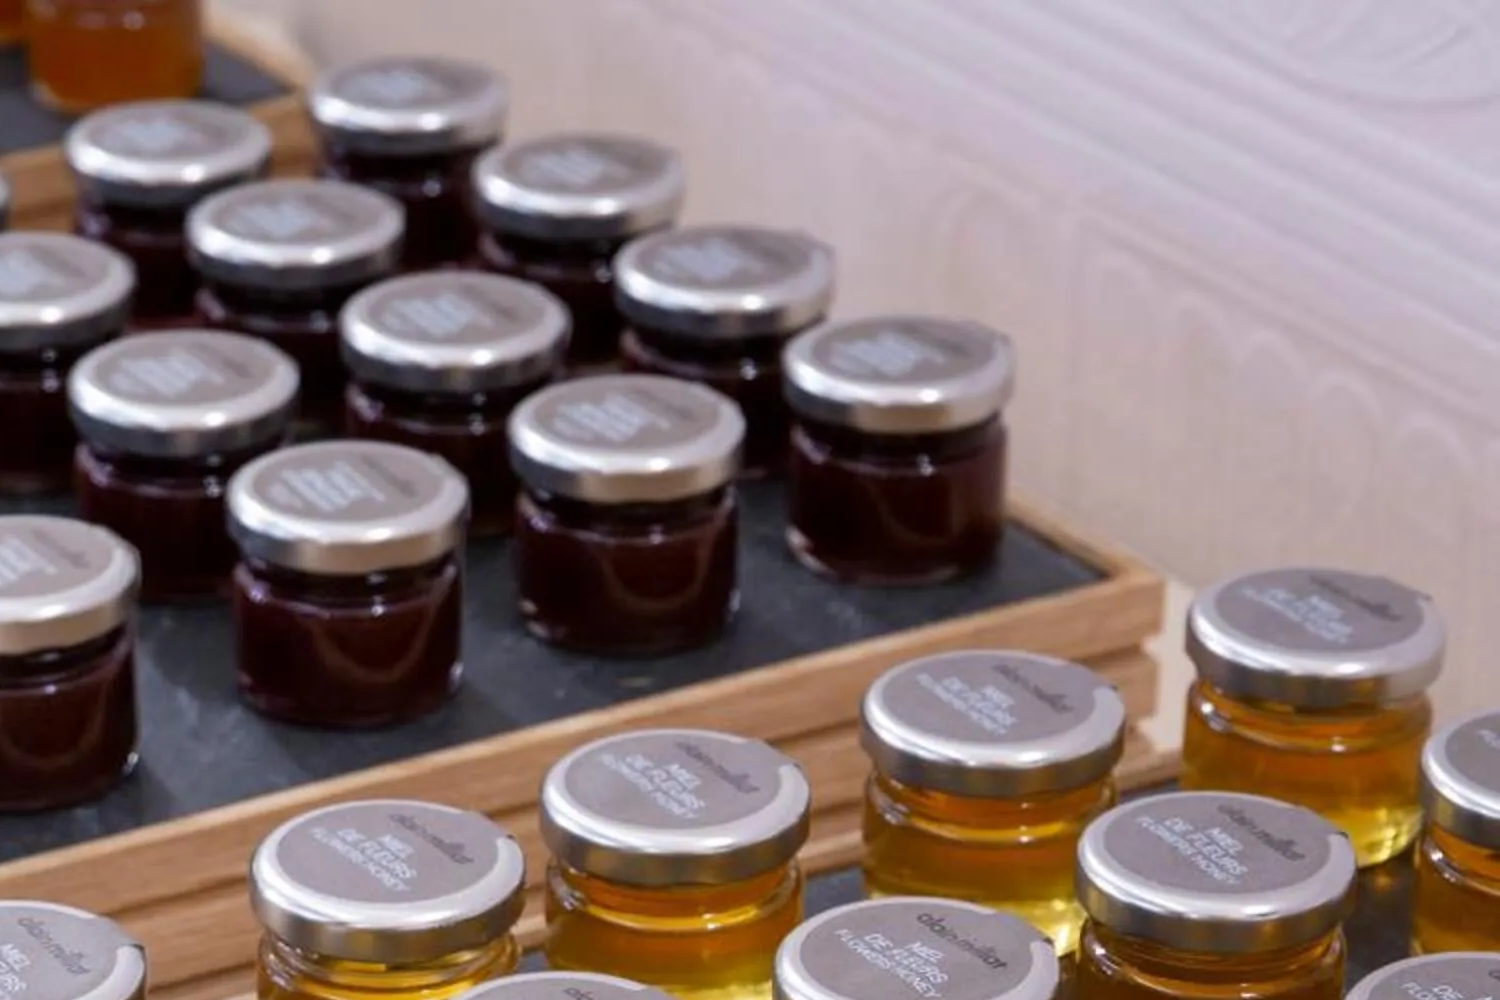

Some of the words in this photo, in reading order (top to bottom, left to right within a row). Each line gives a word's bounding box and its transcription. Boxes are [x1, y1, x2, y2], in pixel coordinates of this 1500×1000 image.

[1165, 819, 1194, 833] DE
[1187, 834, 1247, 874] FLEURS
[1206, 828, 1243, 854] MIEL
[864, 933, 893, 949] DE
[886, 948, 949, 985] FLEURS
[905, 941, 945, 964] MIEL
